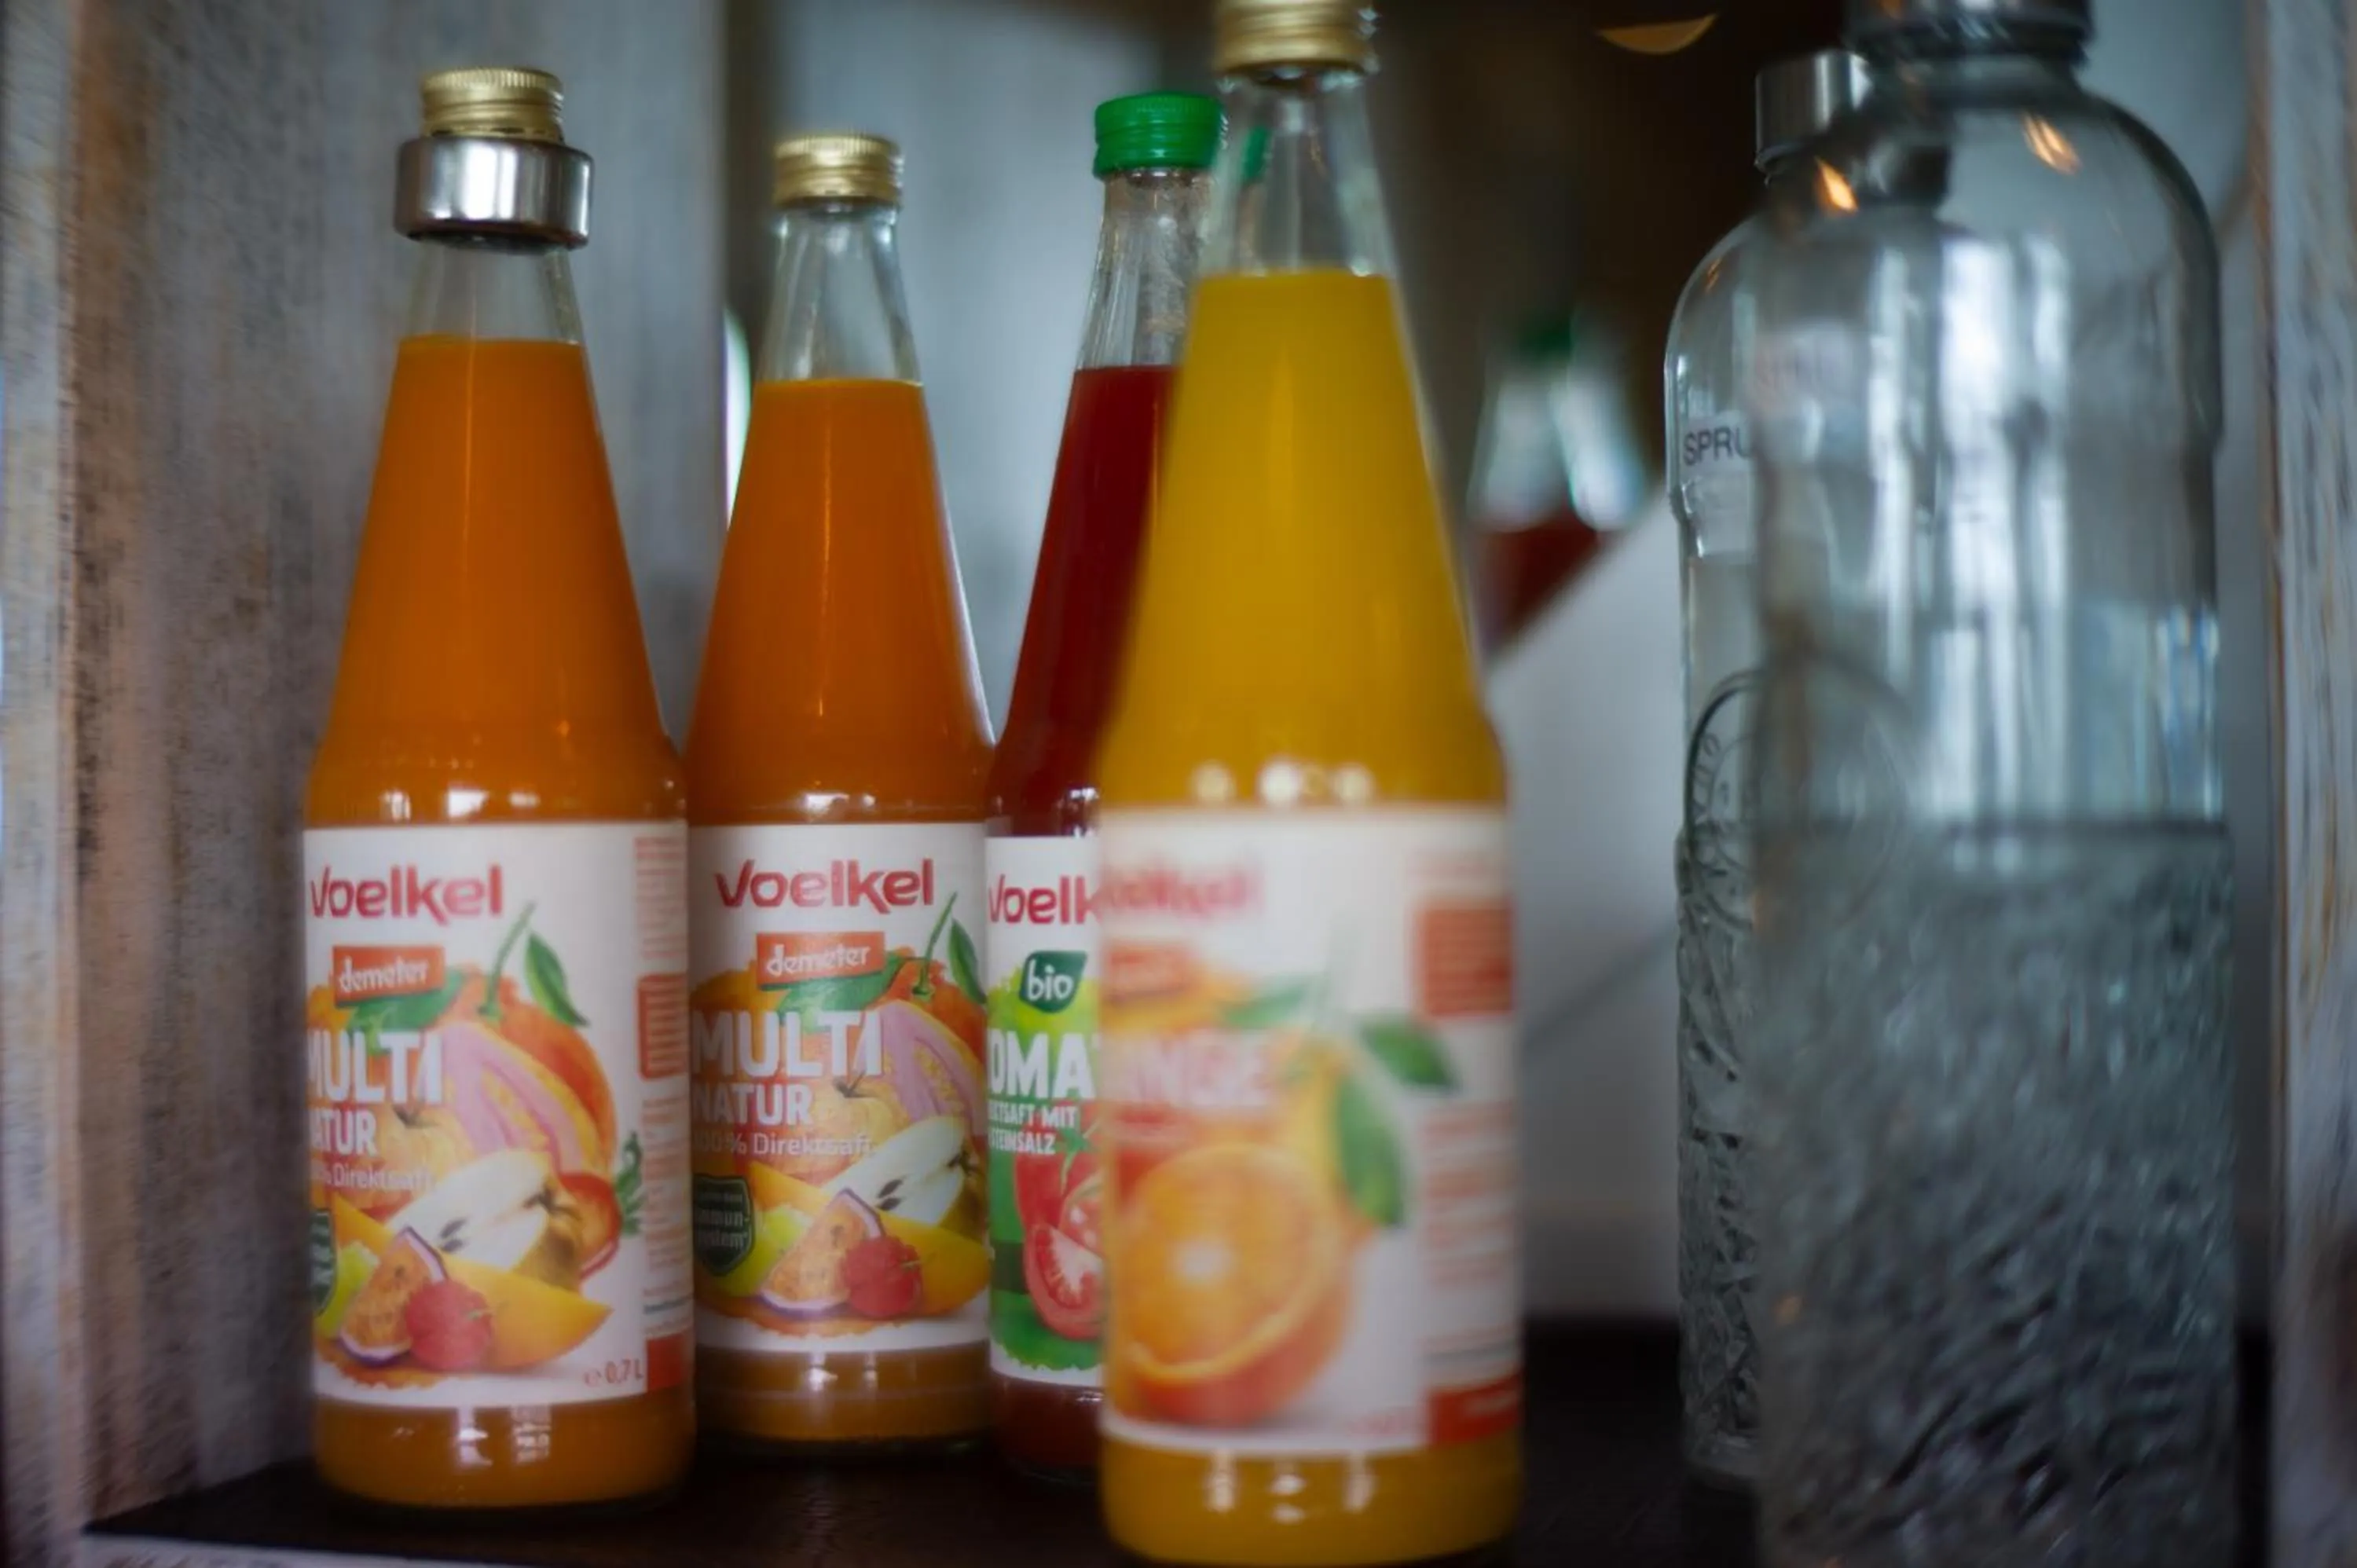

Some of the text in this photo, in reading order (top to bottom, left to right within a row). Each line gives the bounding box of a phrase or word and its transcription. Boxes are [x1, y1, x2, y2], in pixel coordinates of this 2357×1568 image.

[310, 865, 504, 926] Voelkel
[714, 858, 934, 914] Voelkel
[339, 955, 429, 993] demeter
[766, 942, 871, 976] demeter
[1027, 958, 1075, 1001] bio
[690, 1009, 882, 1078] MULTI
[988, 1028, 1102, 1098] OMA
[693, 1081, 813, 1127] NATUR
[1041, 1103, 1077, 1129] MIT
